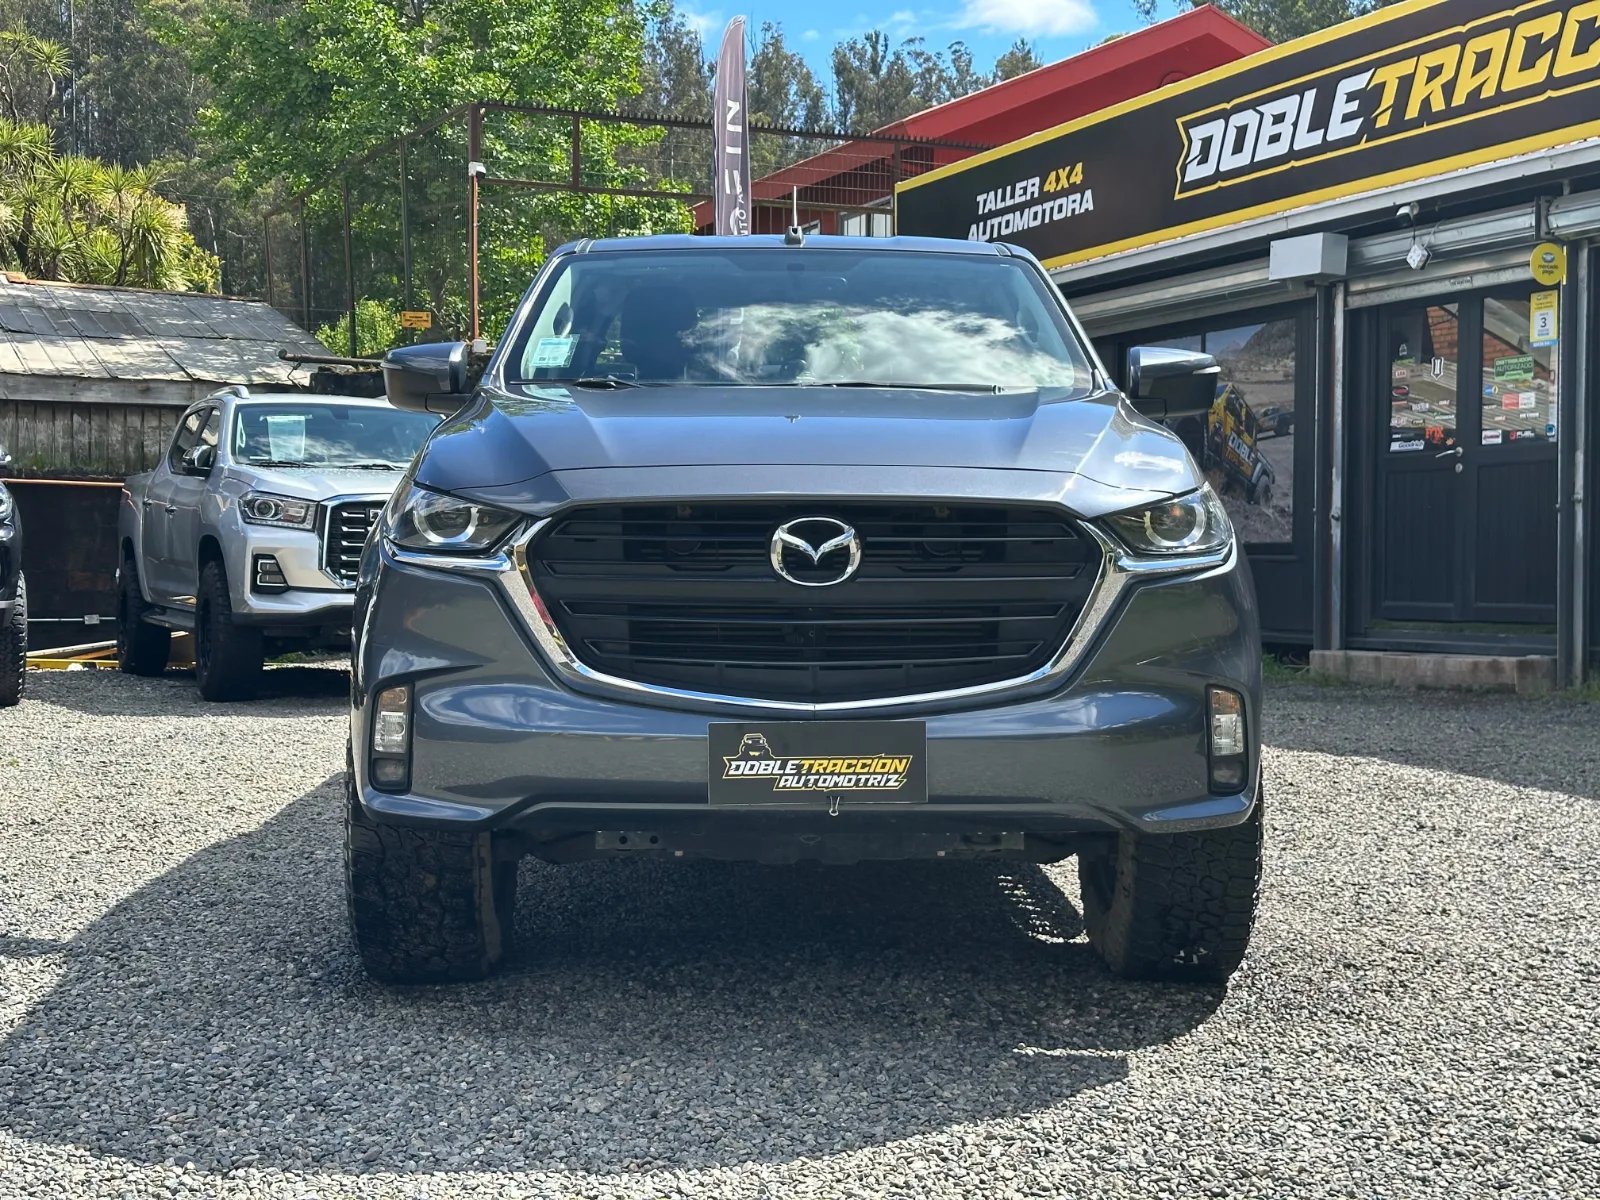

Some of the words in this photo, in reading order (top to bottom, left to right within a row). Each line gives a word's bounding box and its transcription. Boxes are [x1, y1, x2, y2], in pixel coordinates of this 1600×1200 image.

[977, 176, 1040, 215] TALLER
[1043, 162, 1083, 193] 4X4
[968, 189, 1094, 241] AUTOMOTORA
[1540, 317, 1547, 328] 3
[1228, 431, 1255, 466] DOBLE
[778, 774, 901, 788] AUTOMOTRIZ
